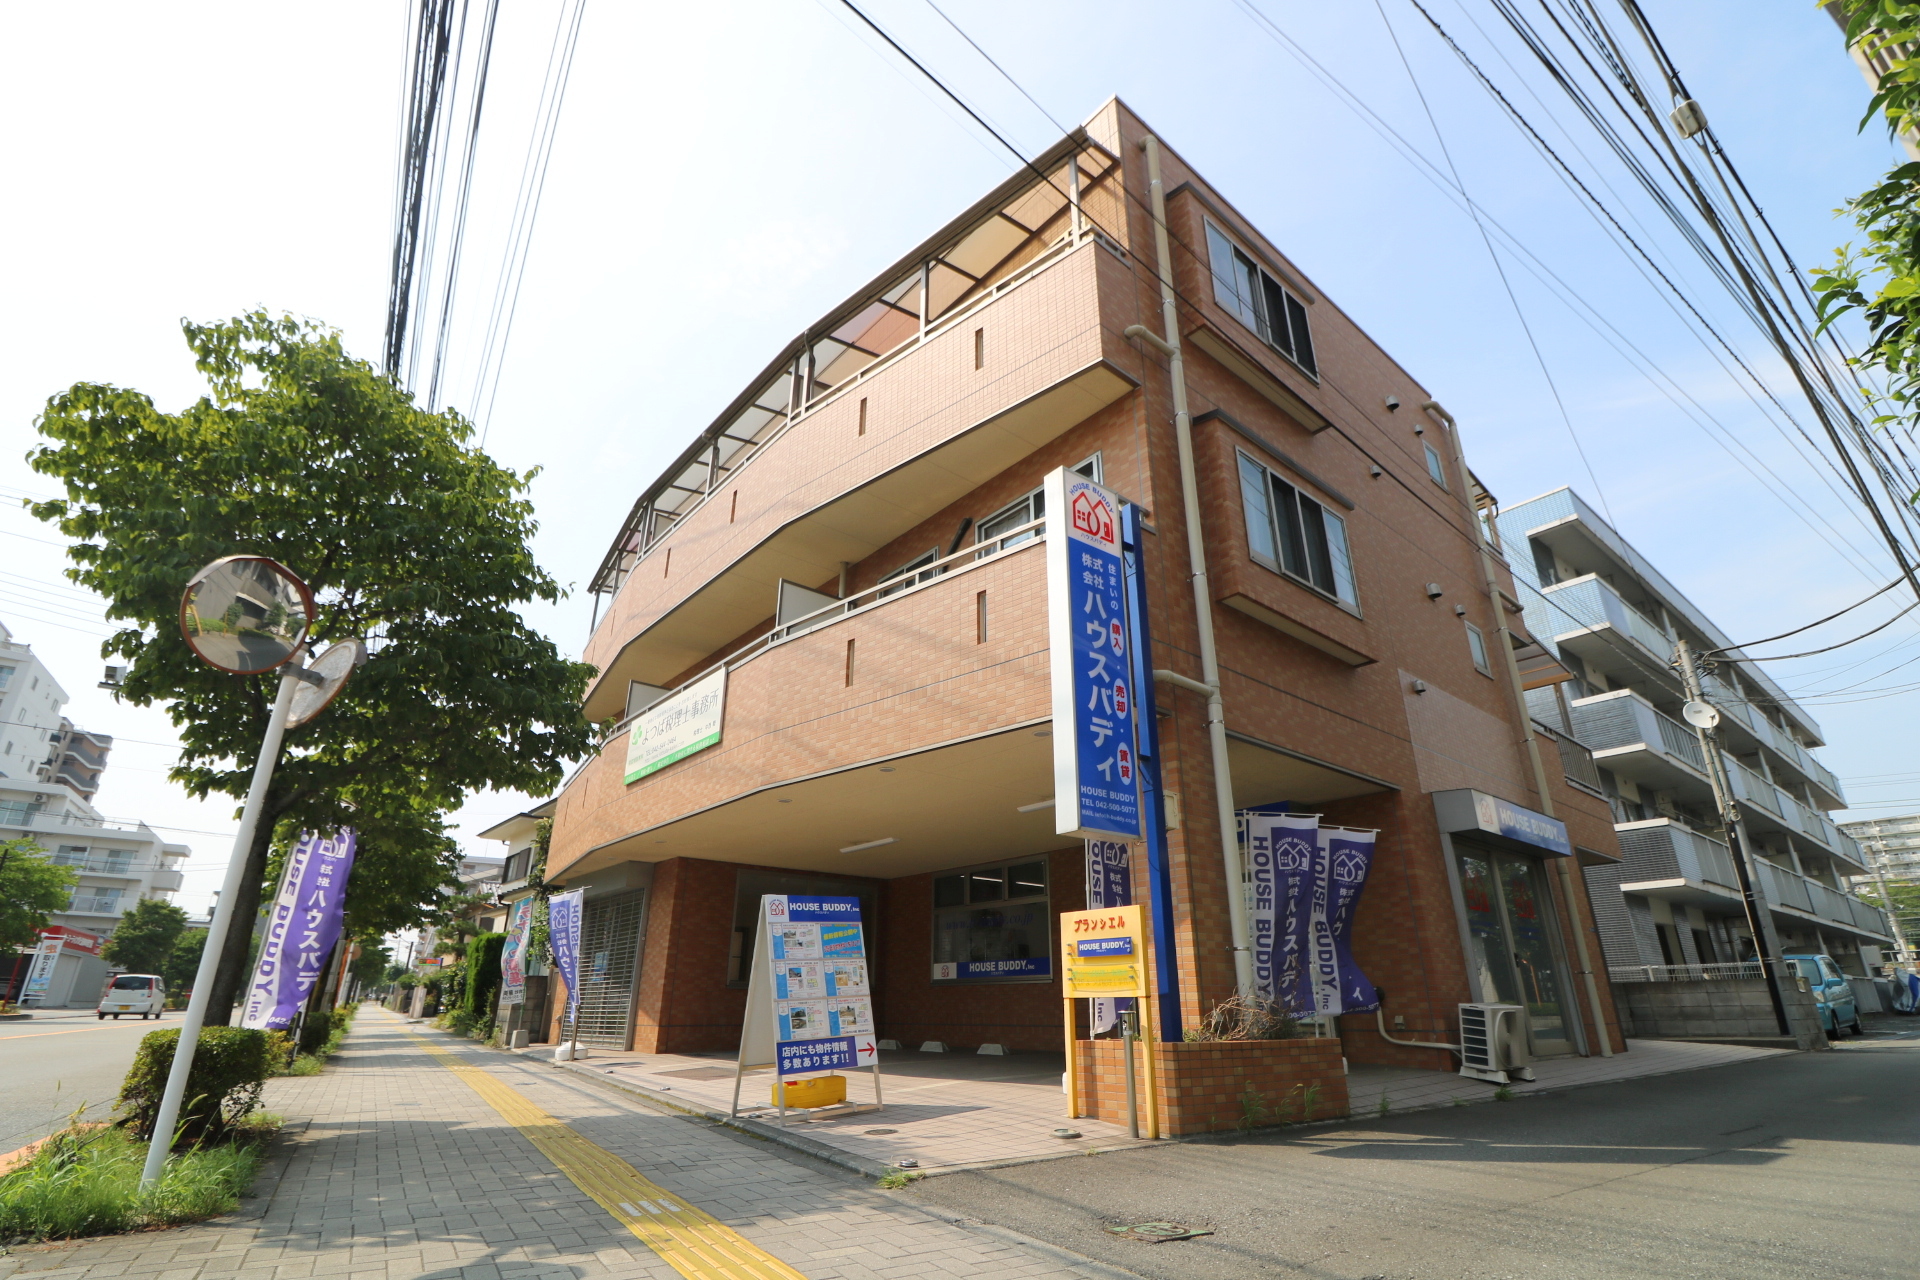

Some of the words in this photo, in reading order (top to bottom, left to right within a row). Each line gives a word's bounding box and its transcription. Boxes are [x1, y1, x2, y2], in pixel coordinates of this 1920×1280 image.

[1069, 483, 1090, 496] HOUSE
[1092, 486, 1115, 513] BUDDY
[1081, 785, 1108, 798] HOUSE
[1109, 790, 1135, 803] BUDDY
[1081, 797, 1095, 807] TEL
[1081, 809, 1094, 817] MAIL
[1500, 807, 1531, 832] HOUSE
[1276, 837, 1292, 849] HOUSE
[1293, 838, 1312, 853] BUDDY
[1332, 848, 1350, 860] HOUSE
[1091, 842, 1103, 905] OUSE
[1253, 836, 1272, 911] HOUSE
[789, 902, 820, 911] HOUSE
[1079, 942, 1100, 951] HOUSE
[969, 962, 996, 972] HOUSE
[1322, 993, 1331, 1010] Inc
[248, 1001, 262, 1022] Inc
[1097, 1002, 1105, 1022] Inc
[782, 1041, 849, 1058] 店内にも物件情報
